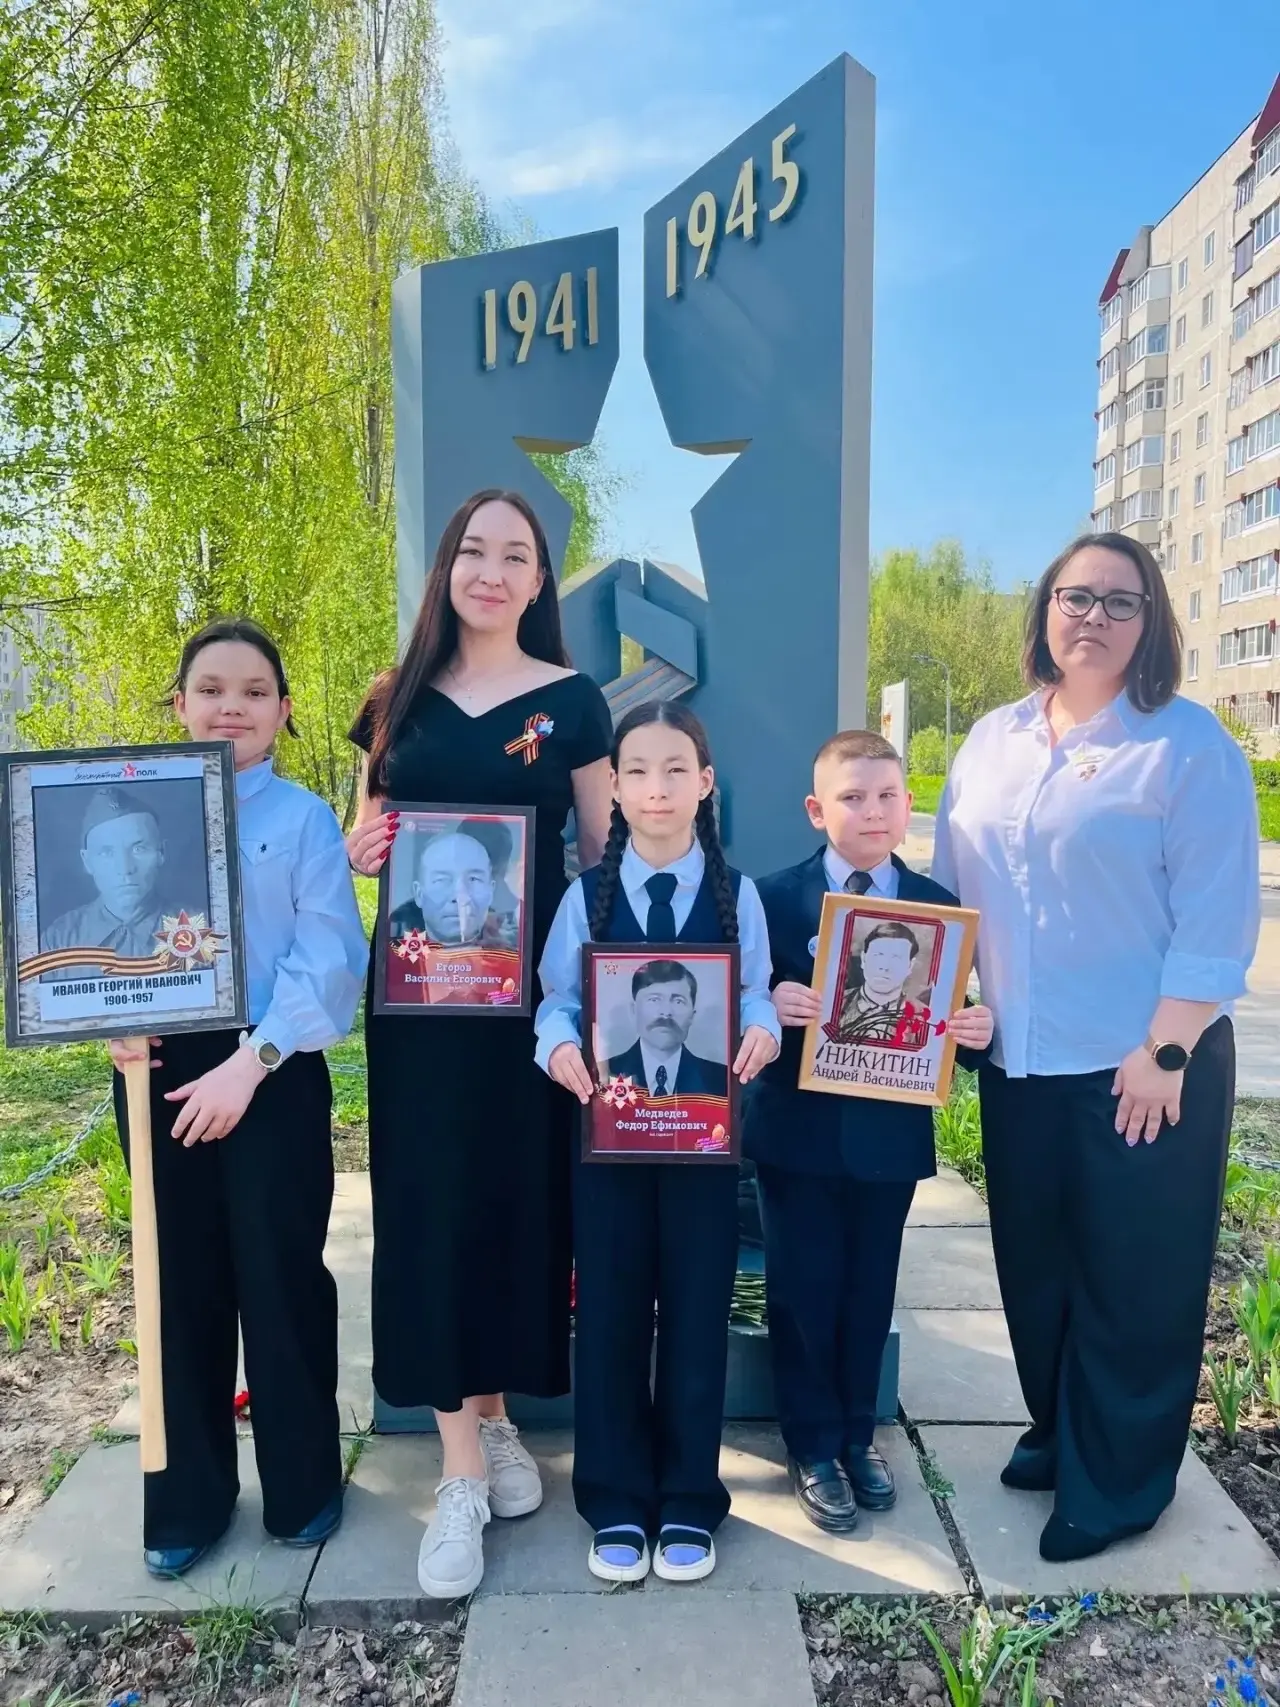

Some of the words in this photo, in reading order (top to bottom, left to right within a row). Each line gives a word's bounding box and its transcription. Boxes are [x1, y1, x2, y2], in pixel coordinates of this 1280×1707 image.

[666, 122, 800, 299] 1945
[483, 267, 599, 371] 1941
[435, 962, 472, 974] Егоров
[52, 984, 96, 997] ИВАНОВ
[98, 977, 143, 993] ГЕОРГИЙ
[145, 974, 202, 989] ИВАНОВИЧ
[404, 973, 450, 983] Василий
[452, 974, 502, 985] Егорович
[103, 992, 154, 1006] 1900-1957
[824, 1045, 932, 1077] НИКИТИН
[811, 1064, 859, 1082] Андрей
[863, 1070, 935, 1092] Васильевич
[634, 1108, 689, 1119] Медведев
[615, 1119, 649, 1132] Федор
[650, 1120, 708, 1132] Ефимович
